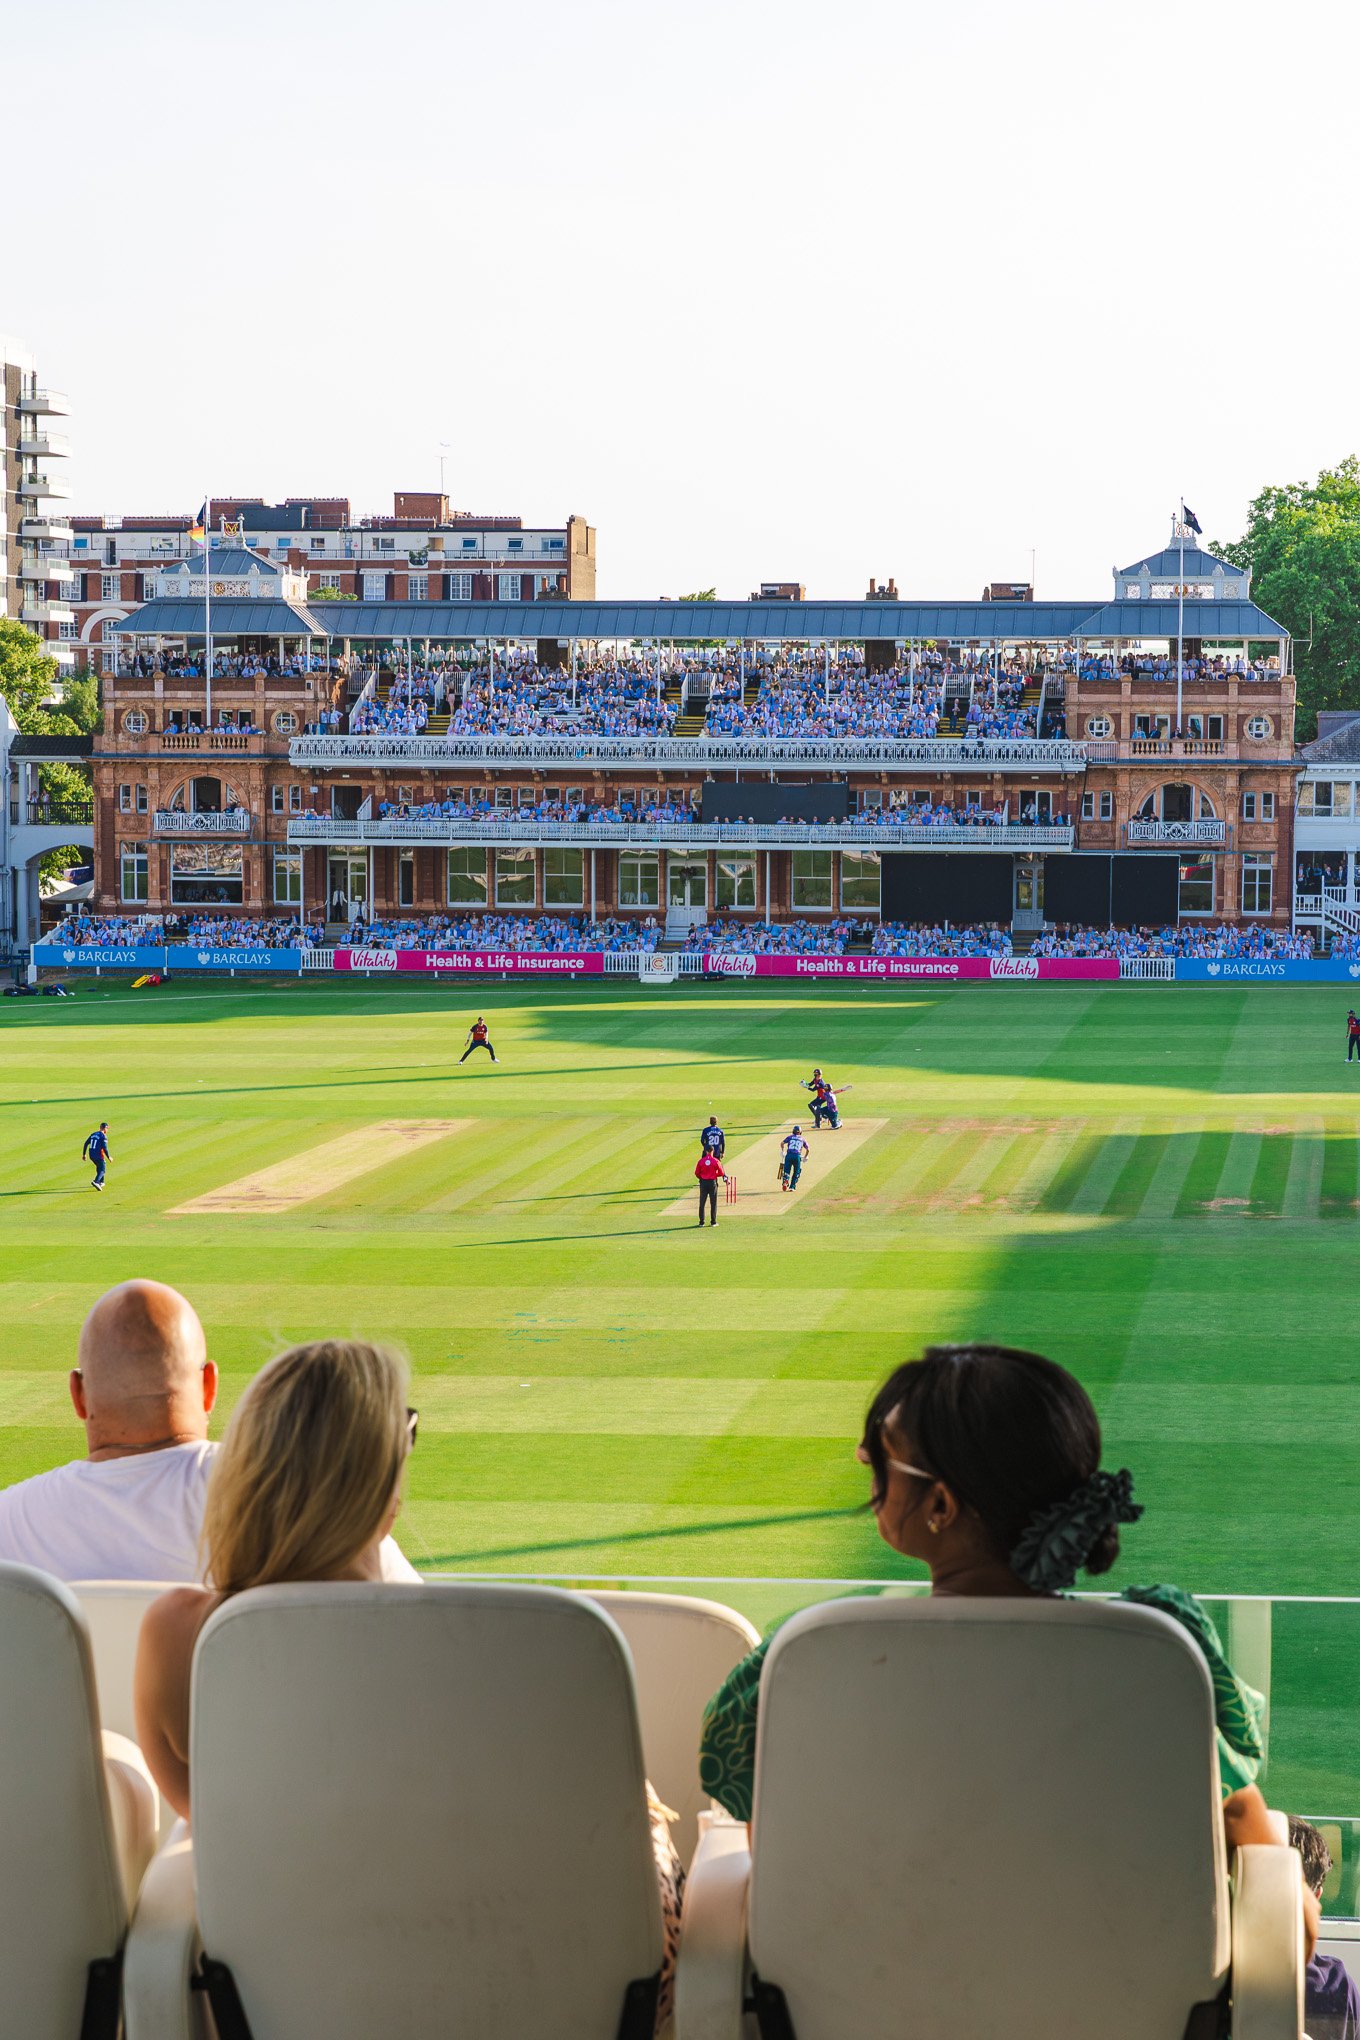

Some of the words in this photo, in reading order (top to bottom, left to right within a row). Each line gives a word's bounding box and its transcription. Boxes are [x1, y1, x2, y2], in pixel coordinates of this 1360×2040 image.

[78, 951, 136, 962] BARCLAYS
[213, 953, 271, 964] BARCLAYS
[353, 950, 395, 970] Vitality
[425, 954, 472, 968] Health
[475, 956, 485, 968] &
[488, 955, 514, 968] Life
[517, 956, 585, 969] insurance
[711, 954, 754, 974] Vitality
[796, 959, 844, 972] Health
[846, 961, 856, 972] &
[860, 960, 887, 973] Life
[890, 960, 959, 974] insurance
[992, 958, 1036, 978] Vitality
[1223, 964, 1285, 975] BARCLAYS
[90, 1139, 97, 1149] 11
[708, 1135, 720, 1146] 20
